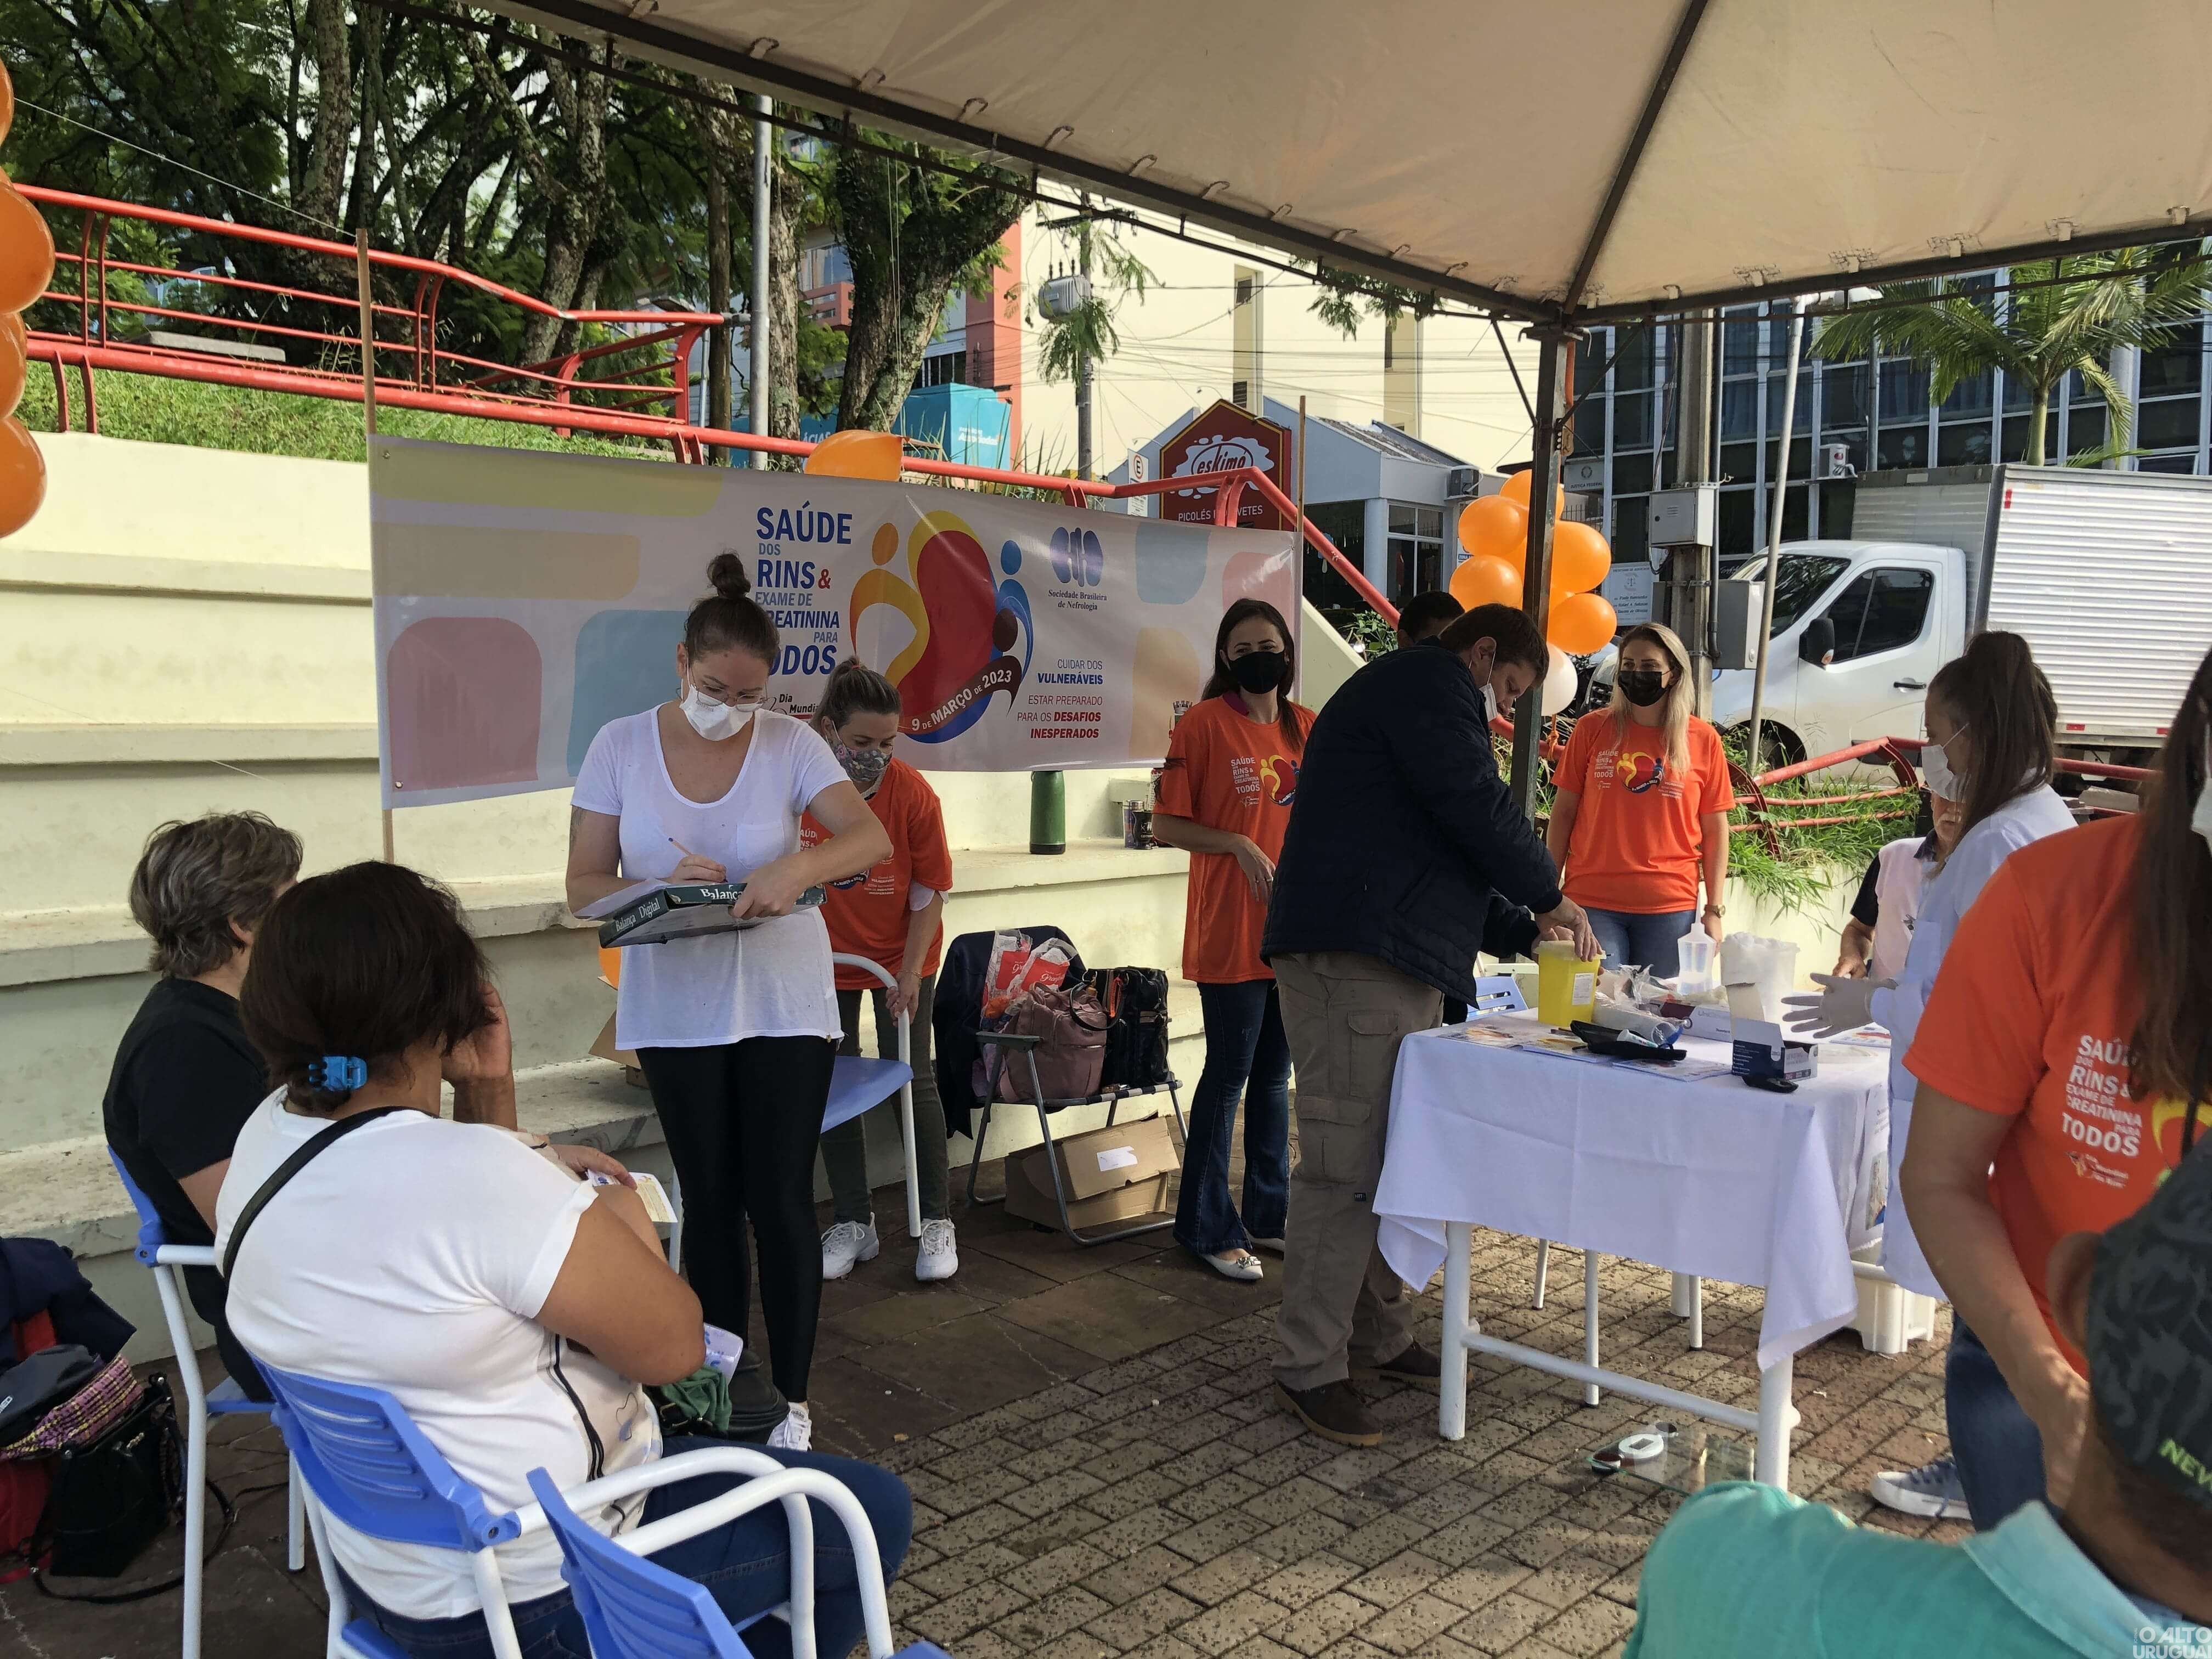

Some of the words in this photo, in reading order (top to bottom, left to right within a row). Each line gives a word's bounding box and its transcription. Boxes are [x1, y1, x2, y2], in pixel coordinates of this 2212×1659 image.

[1178, 508, 1211, 522] PICOLÉS
[1237, 505, 1263, 517] VETES
[756, 500, 853, 544] SAÚDE
[759, 543, 781, 556] DOS
[757, 559, 816, 589] RINS
[818, 568, 832, 589] &
[755, 591, 795, 606] EXAME
[797, 592, 813, 606] DE
[1048, 589, 1078, 599] Sociedade
[1080, 592, 1107, 601] Brasileira
[1067, 601, 1098, 612] Nefrologia
[814, 631, 838, 643] PARA
[1057, 659, 1085, 669] CUIDAR
[1087, 660, 1103, 670] DOS
[1037, 671, 1103, 685] VULNERÁVEIS
[779, 693, 793, 703] Dia
[911, 718, 920, 731] 9
[922, 720, 932, 730] DE
[930, 688, 973, 725] MARÇO
[974, 685, 983, 695] DE
[982, 669, 1012, 689] 2023
[1028, 695, 1053, 705] ESTAR
[1056, 696, 1103, 706] PREPARADO
[789, 703, 818, 714] Mundi
[1017, 712, 1038, 721] PARA
[1040, 712, 1052, 721] OS
[1053, 712, 1101, 722] DESAFIOS
[1030, 728, 1099, 739] INESPERADOS
[1231, 756, 1255, 766] SAÚDE
[1233, 767, 1249, 776] RINS
[1235, 784, 1260, 794] TODOS
[615, 913, 637, 933] Balança
[638, 897, 661, 919] Digital
[2069, 1064, 2119, 1095] RINS
[2062, 1111, 2140, 1156] TODOS
